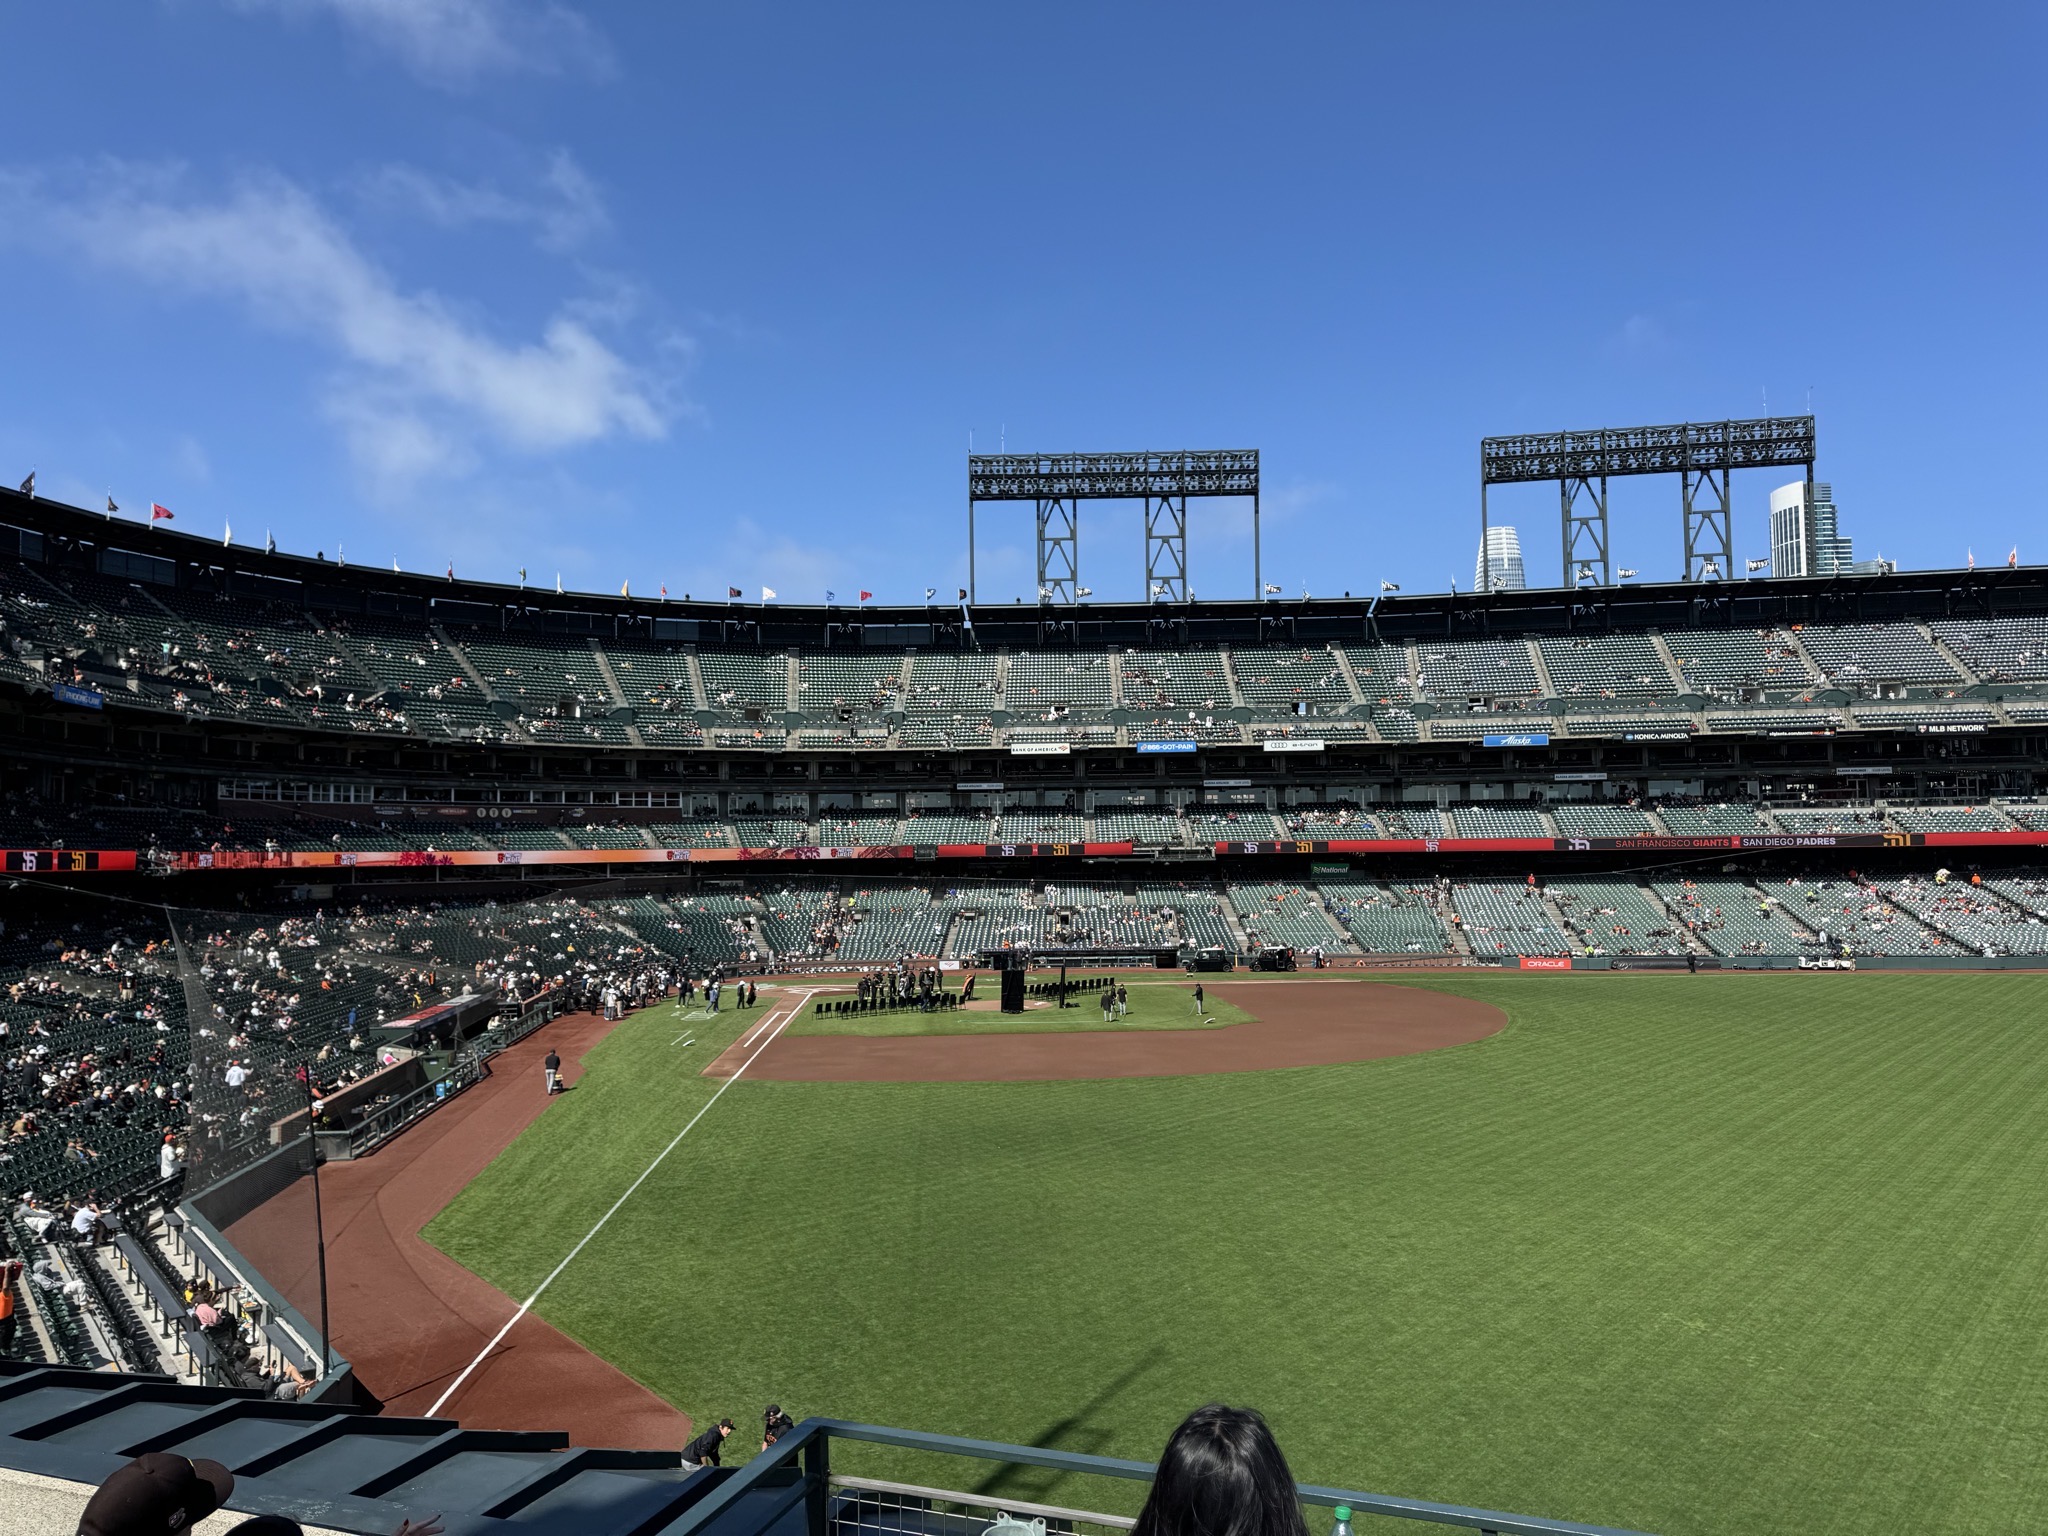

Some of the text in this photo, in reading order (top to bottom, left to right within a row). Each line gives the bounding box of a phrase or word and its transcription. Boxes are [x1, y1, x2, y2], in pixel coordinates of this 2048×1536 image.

[1929, 724, 1985, 733] MLB NETWORK
[1660, 732, 1689, 740] MINOLTA
[1615, 839, 1729, 848] SAN FRANCISCO GIANTS
[1764, 838, 1794, 846] DIEGO
[1796, 837, 1836, 846] PADRES
[1320, 866, 1349, 874] National
